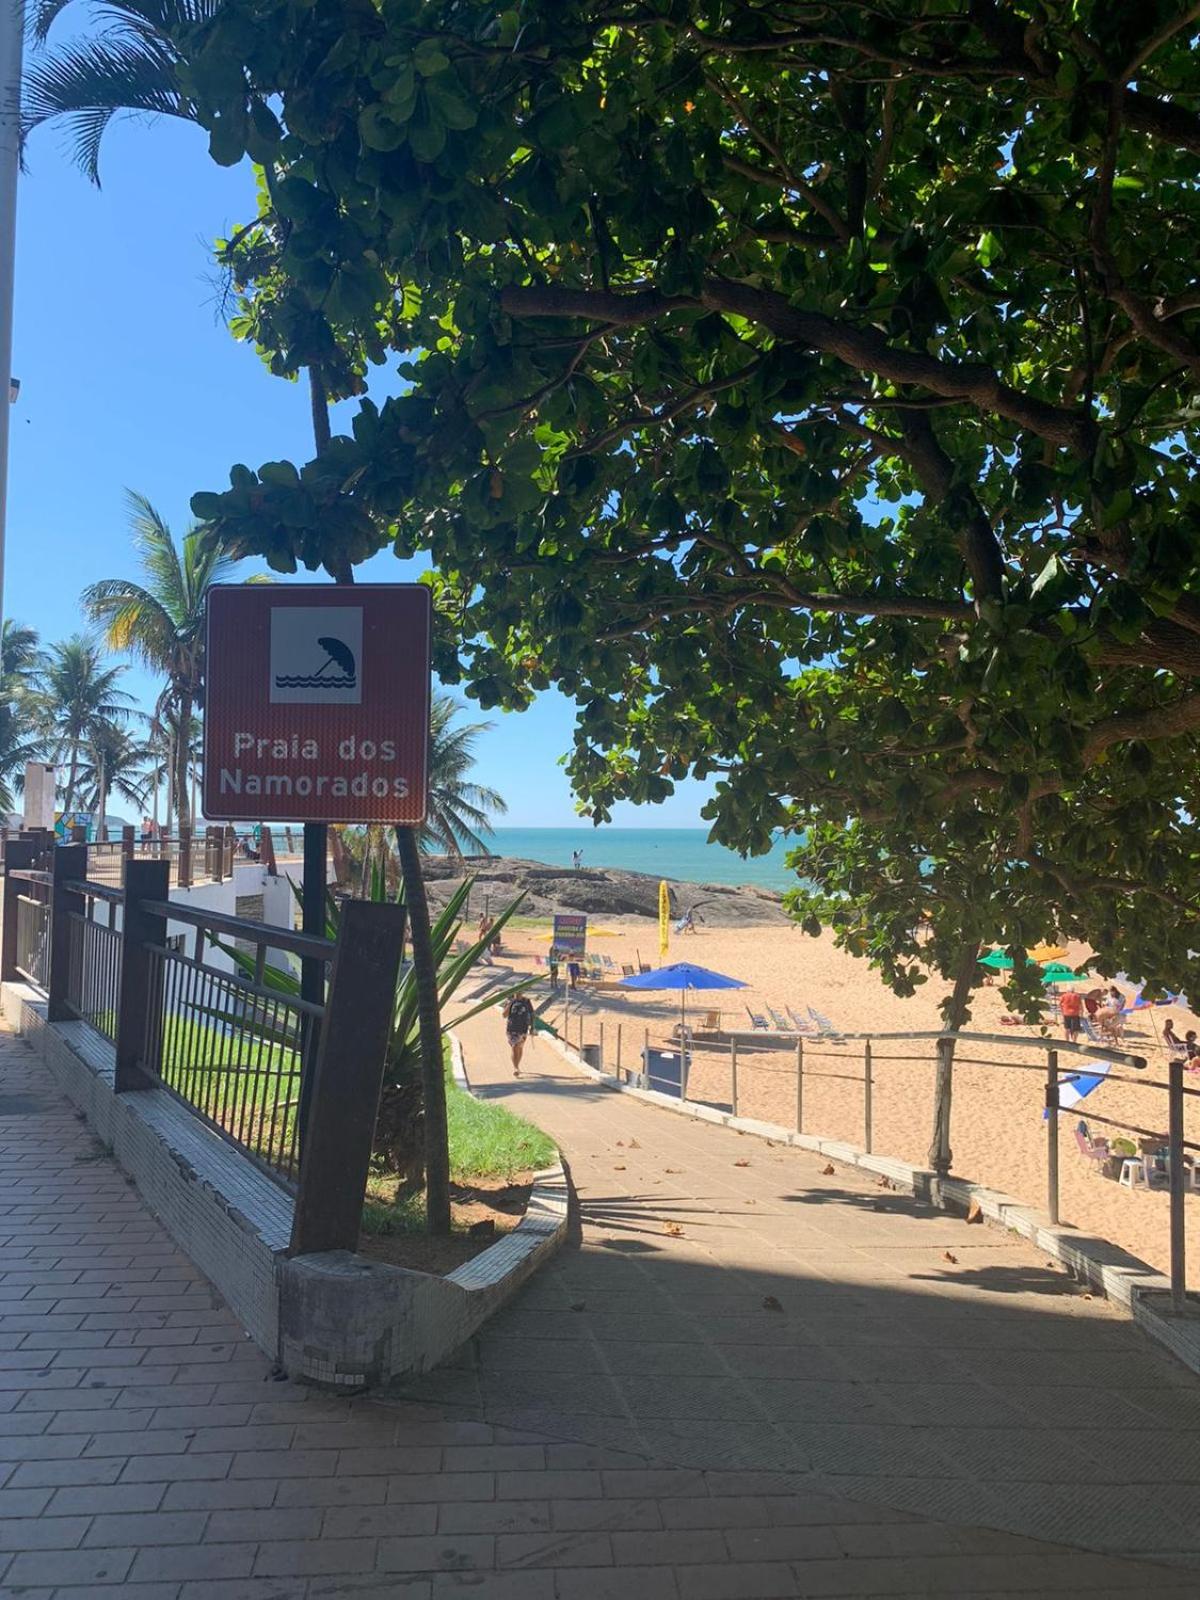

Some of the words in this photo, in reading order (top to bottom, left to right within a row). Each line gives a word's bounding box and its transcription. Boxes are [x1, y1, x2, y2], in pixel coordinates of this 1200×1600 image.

[233, 732, 319, 760] Praia
[338, 735, 397, 761] dos
[219, 768, 410, 798] Namorados
